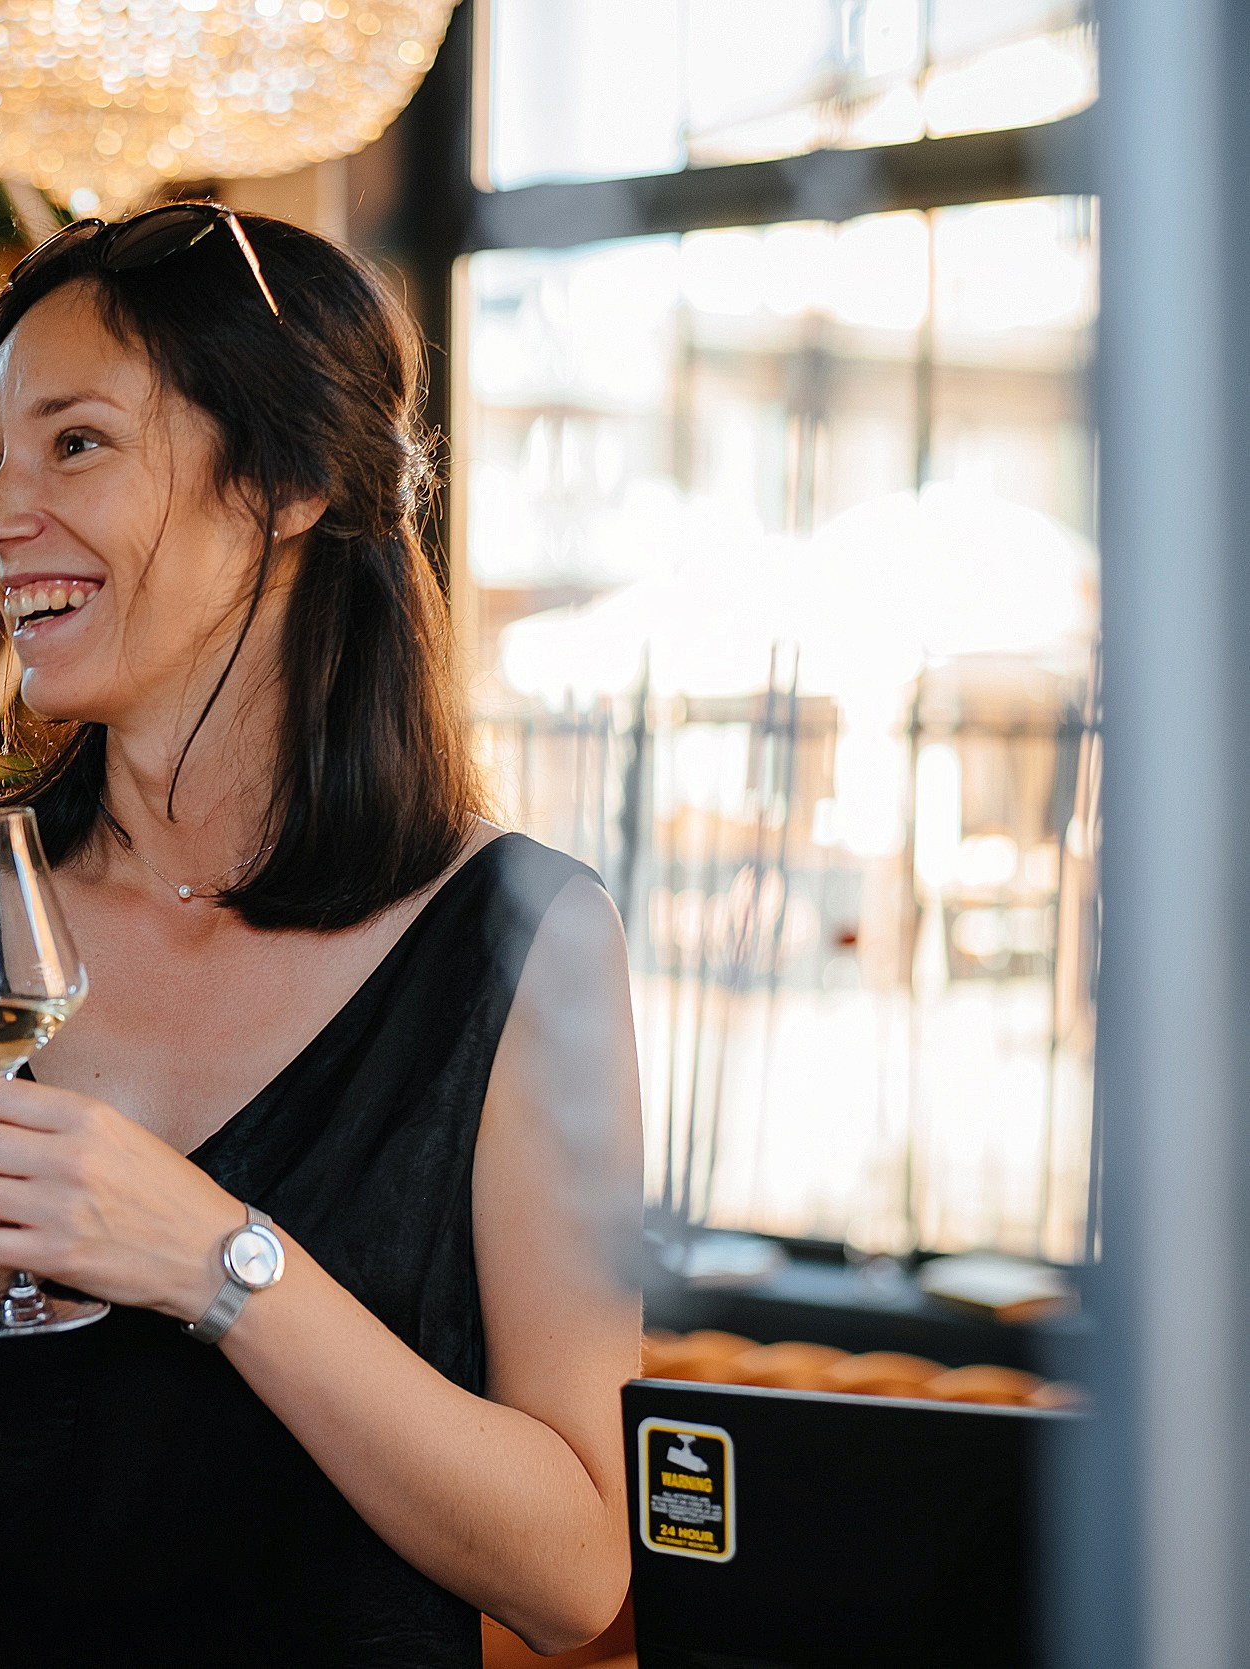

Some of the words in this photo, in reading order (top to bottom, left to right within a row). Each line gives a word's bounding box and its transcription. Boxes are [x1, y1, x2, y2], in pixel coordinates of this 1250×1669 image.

[661, 1471, 713, 1493] WARNING
[660, 1524, 676, 1536] 24
[678, 1527, 714, 1543] HOUR
